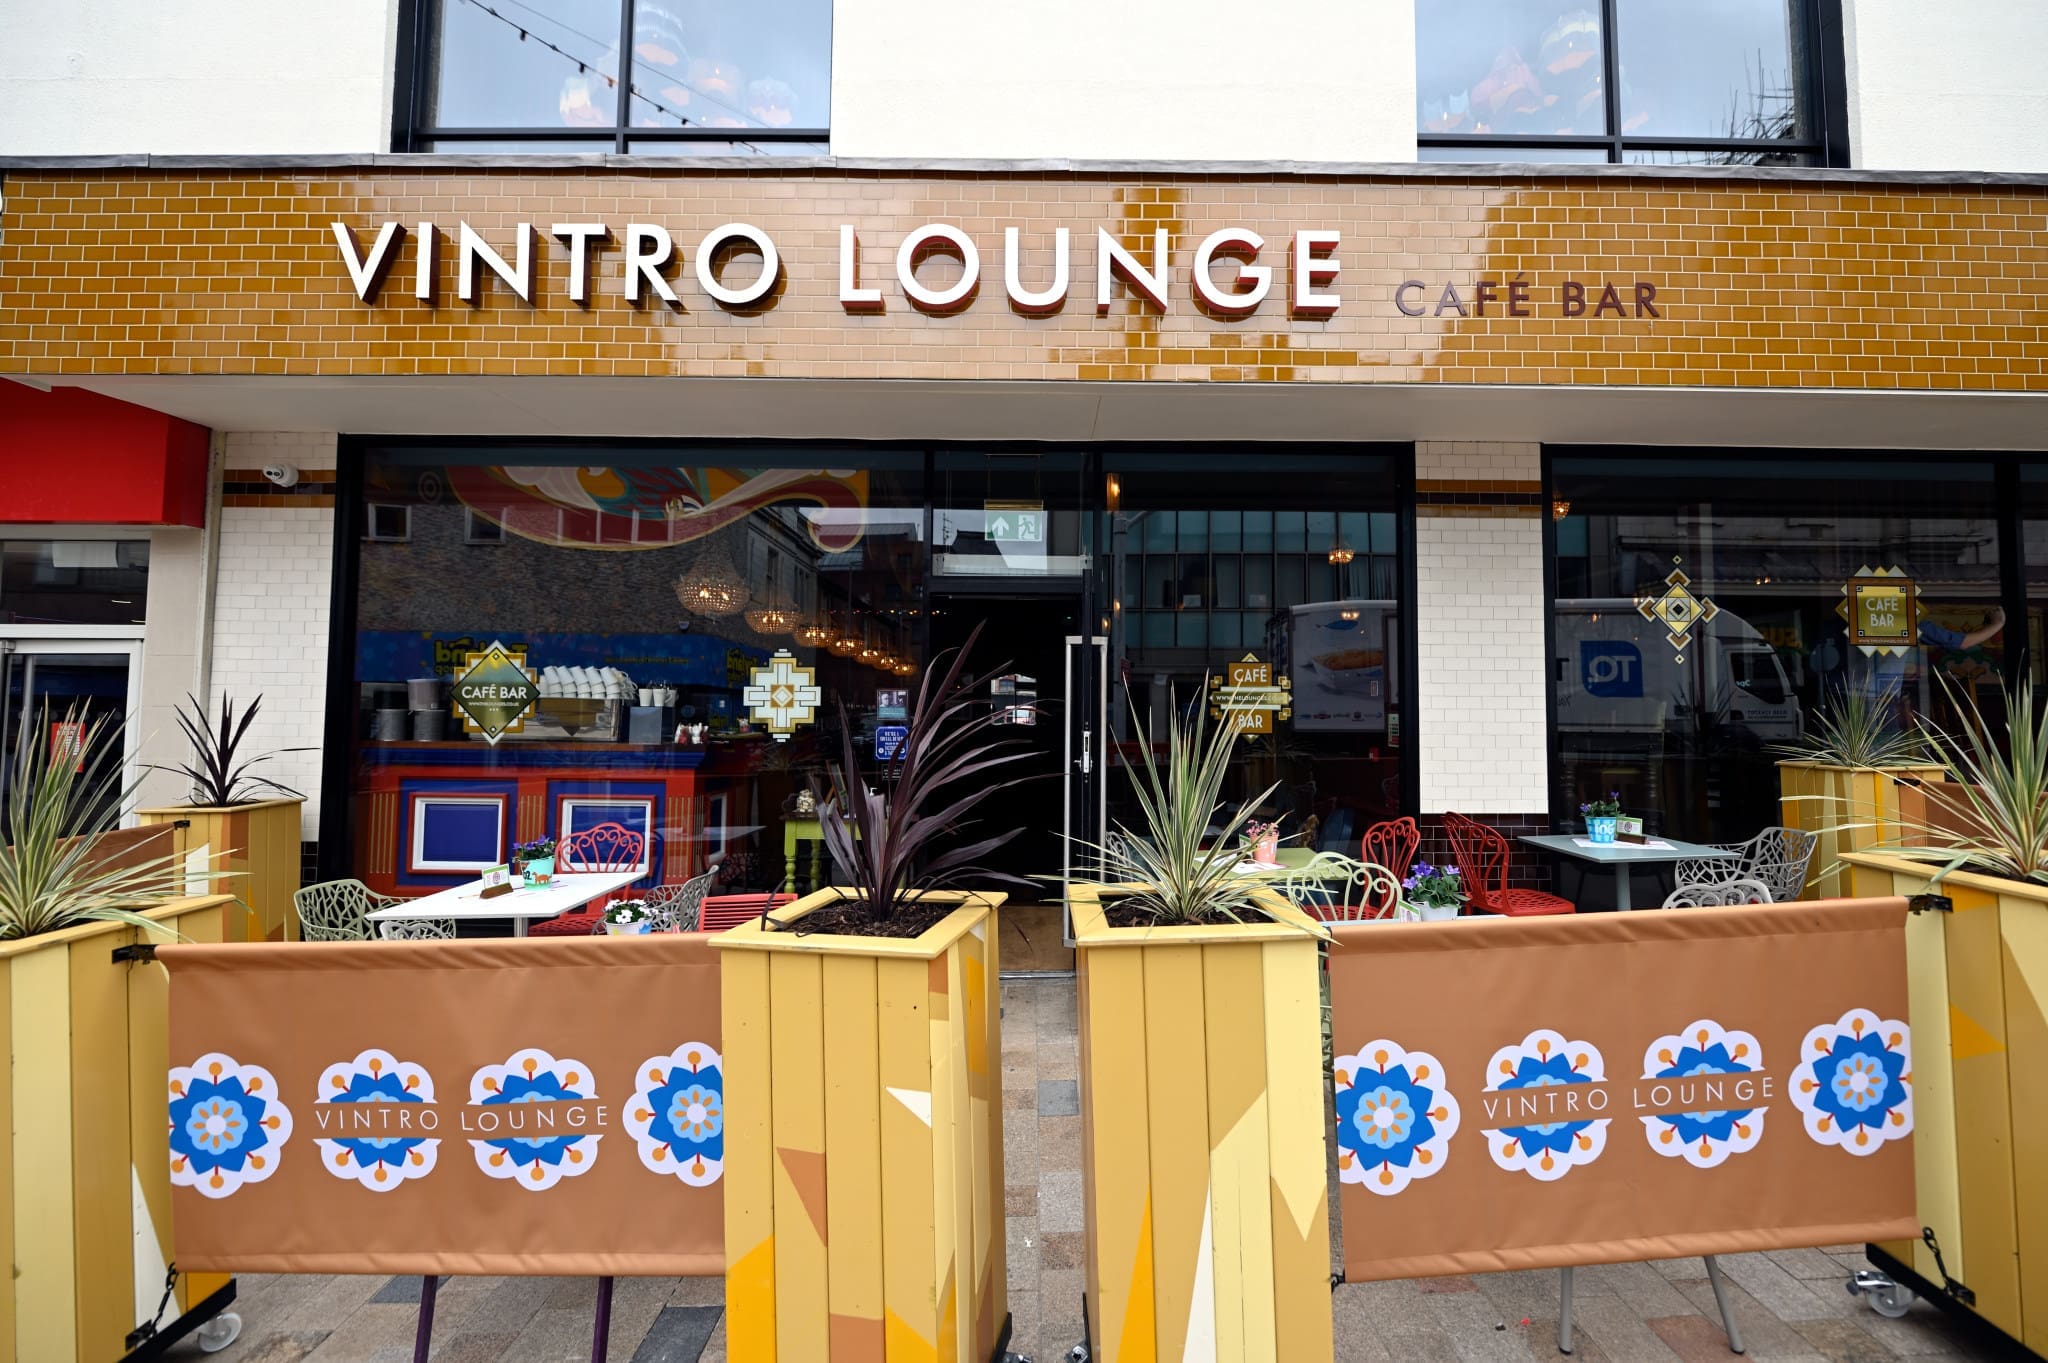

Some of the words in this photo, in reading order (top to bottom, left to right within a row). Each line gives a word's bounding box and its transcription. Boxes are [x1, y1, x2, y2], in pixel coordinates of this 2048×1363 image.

[330, 220, 782, 310] VINTRO
[838, 223, 1342, 315] LOUNGE
[1395, 272, 1530, 317] CAFÉ
[1562, 281, 1661, 318] BAR
[1865, 596, 1899, 612] CAFÉ
[1870, 613, 1895, 627] BAR
[1233, 665, 1268, 683] CAFÉ
[461, 684, 496, 699] CAFÉ
[499, 686, 527, 699] BAR
[1238, 715, 1263, 729] BAR
[1482, 1087, 1609, 1120] VINTRO
[1632, 1076, 1775, 1110] LOUNGE
[314, 1109, 439, 1131] VINTRO
[461, 1105, 609, 1132] LOUNGE
